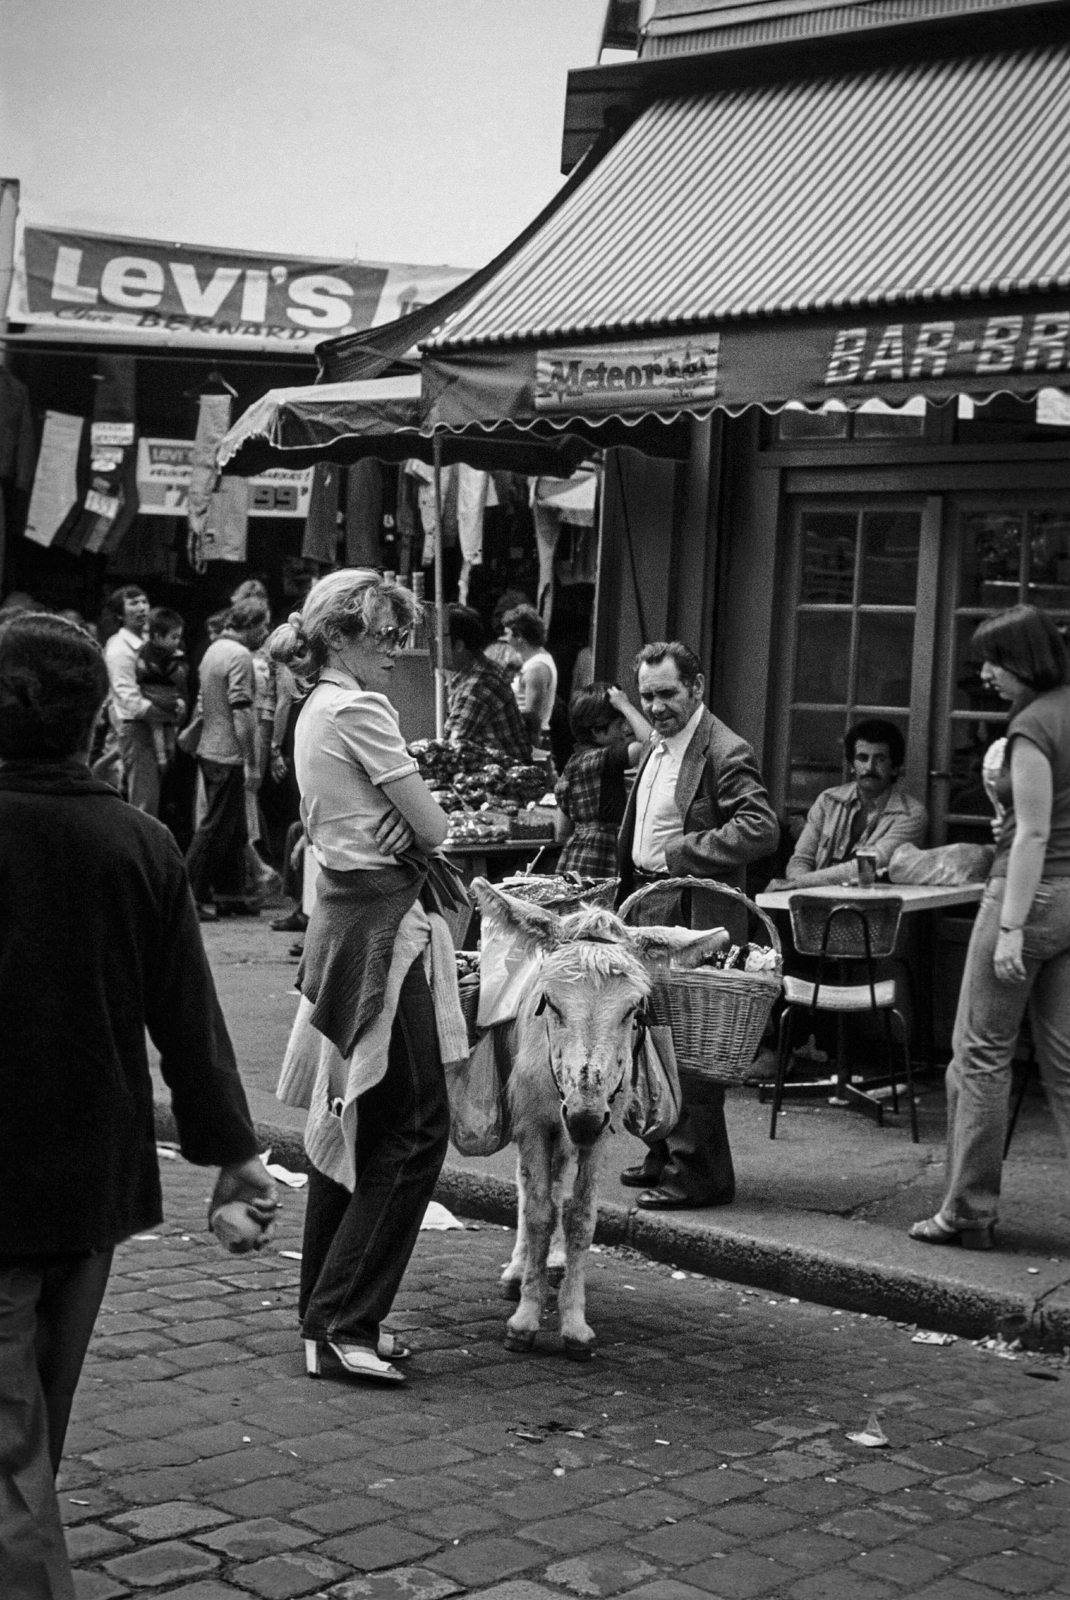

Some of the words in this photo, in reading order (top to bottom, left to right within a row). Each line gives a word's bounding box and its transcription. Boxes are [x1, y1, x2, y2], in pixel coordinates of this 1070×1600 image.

[51, 246, 354, 329] Levi's
[136, 310, 310, 340] BERNARD
[824, 311, 1070, 385] BAR-BR
[545, 359, 663, 399] Meteor
